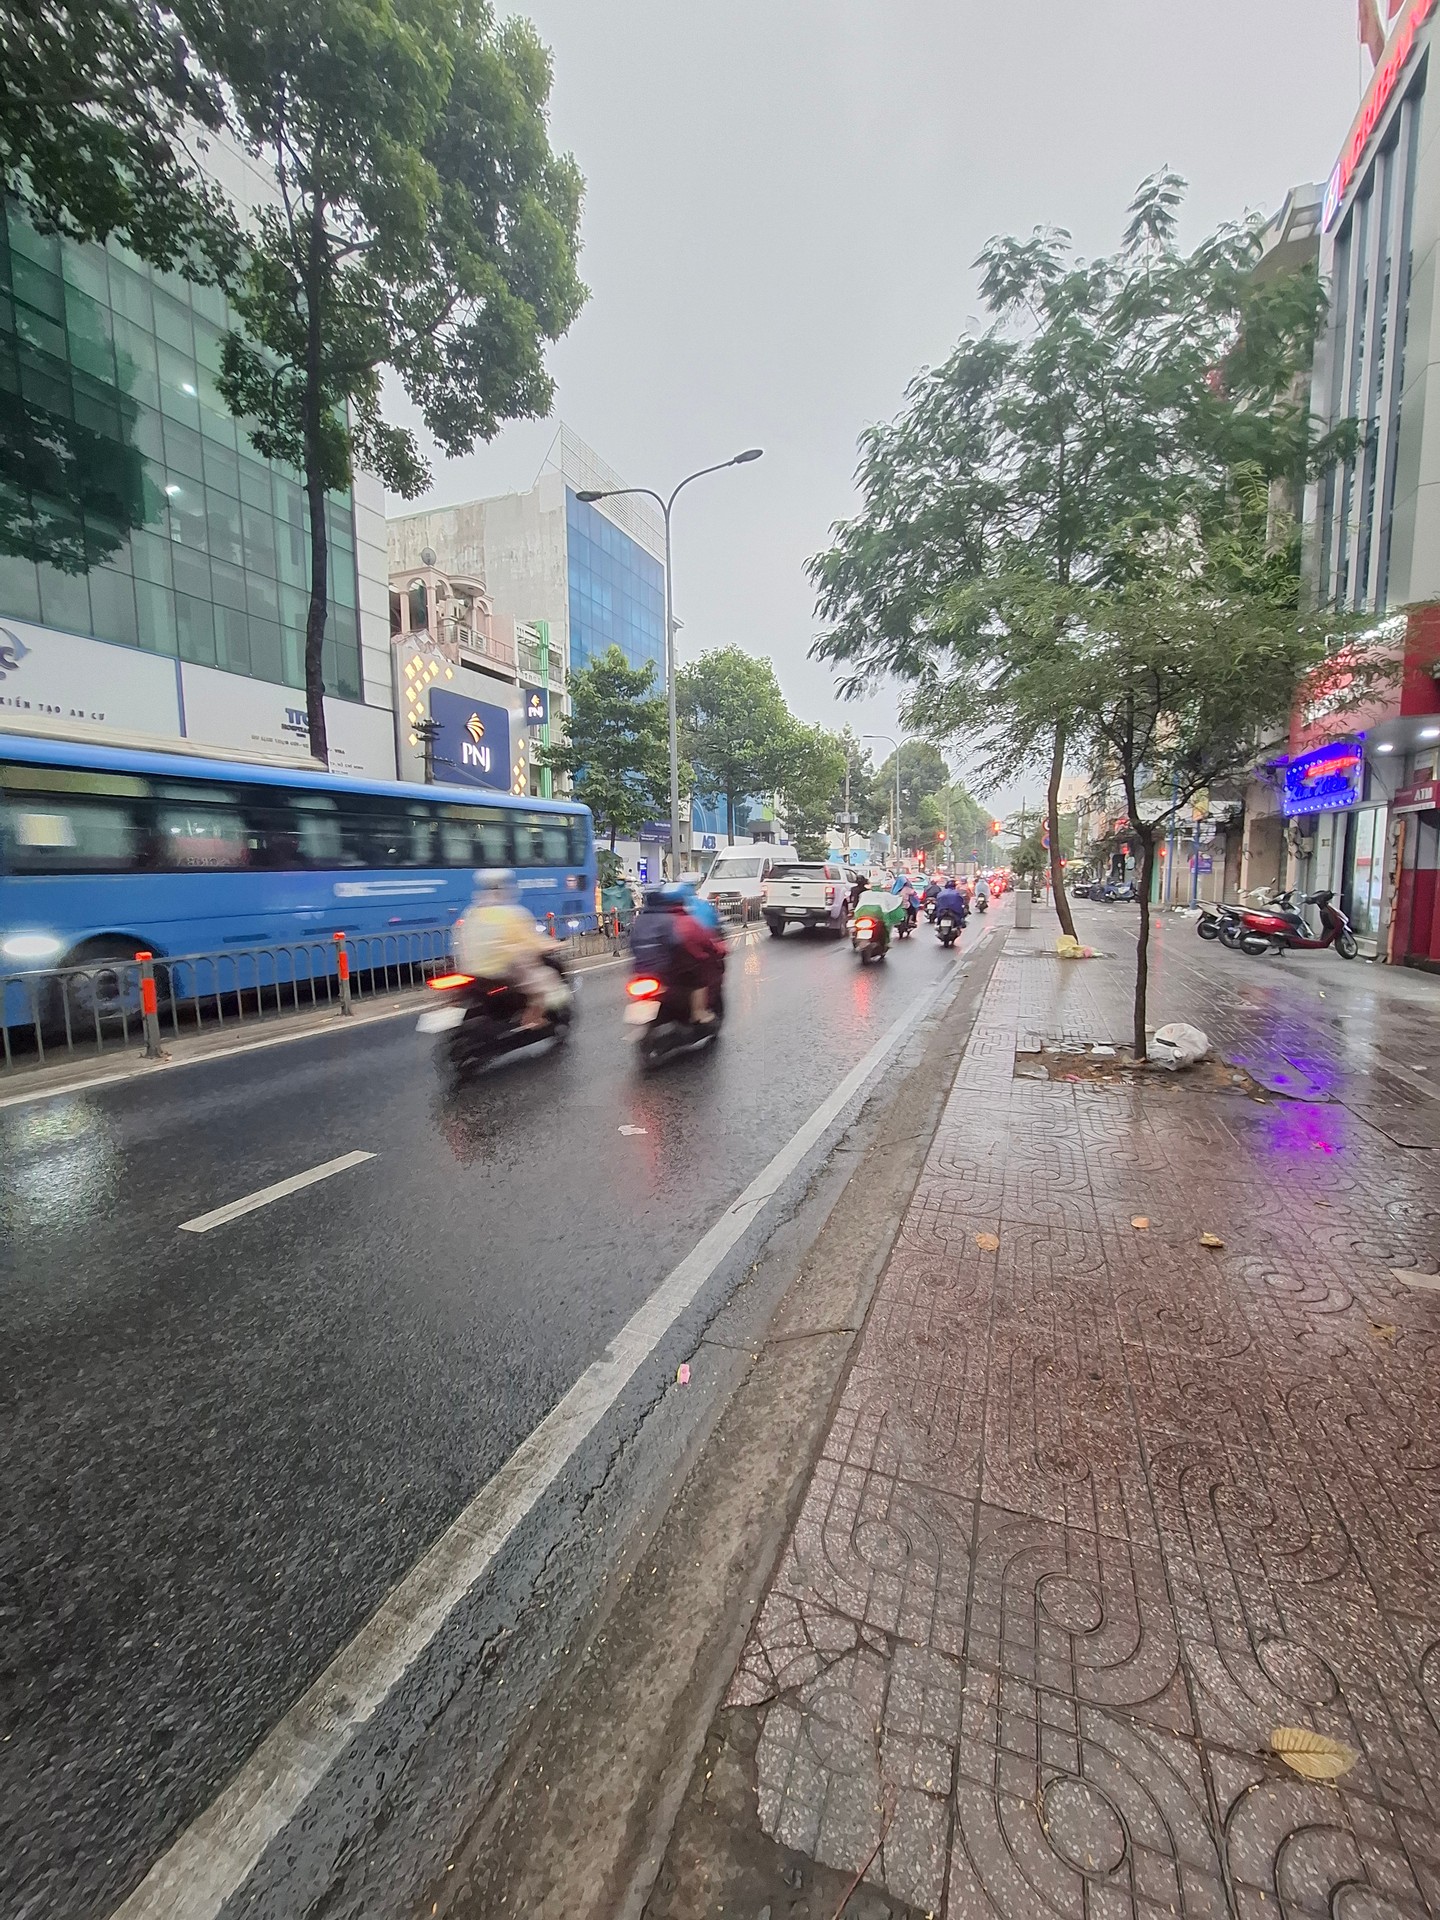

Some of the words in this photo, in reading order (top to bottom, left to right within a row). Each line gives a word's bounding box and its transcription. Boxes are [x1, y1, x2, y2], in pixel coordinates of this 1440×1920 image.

[38, 703, 61, 714] TẠO
[70, 708, 85, 718] AN
[528, 707, 544, 718] PNJ
[462, 742, 490, 773] PNJ
[1414, 787, 1433, 801] ATM
[702, 835, 716, 849] ACB
